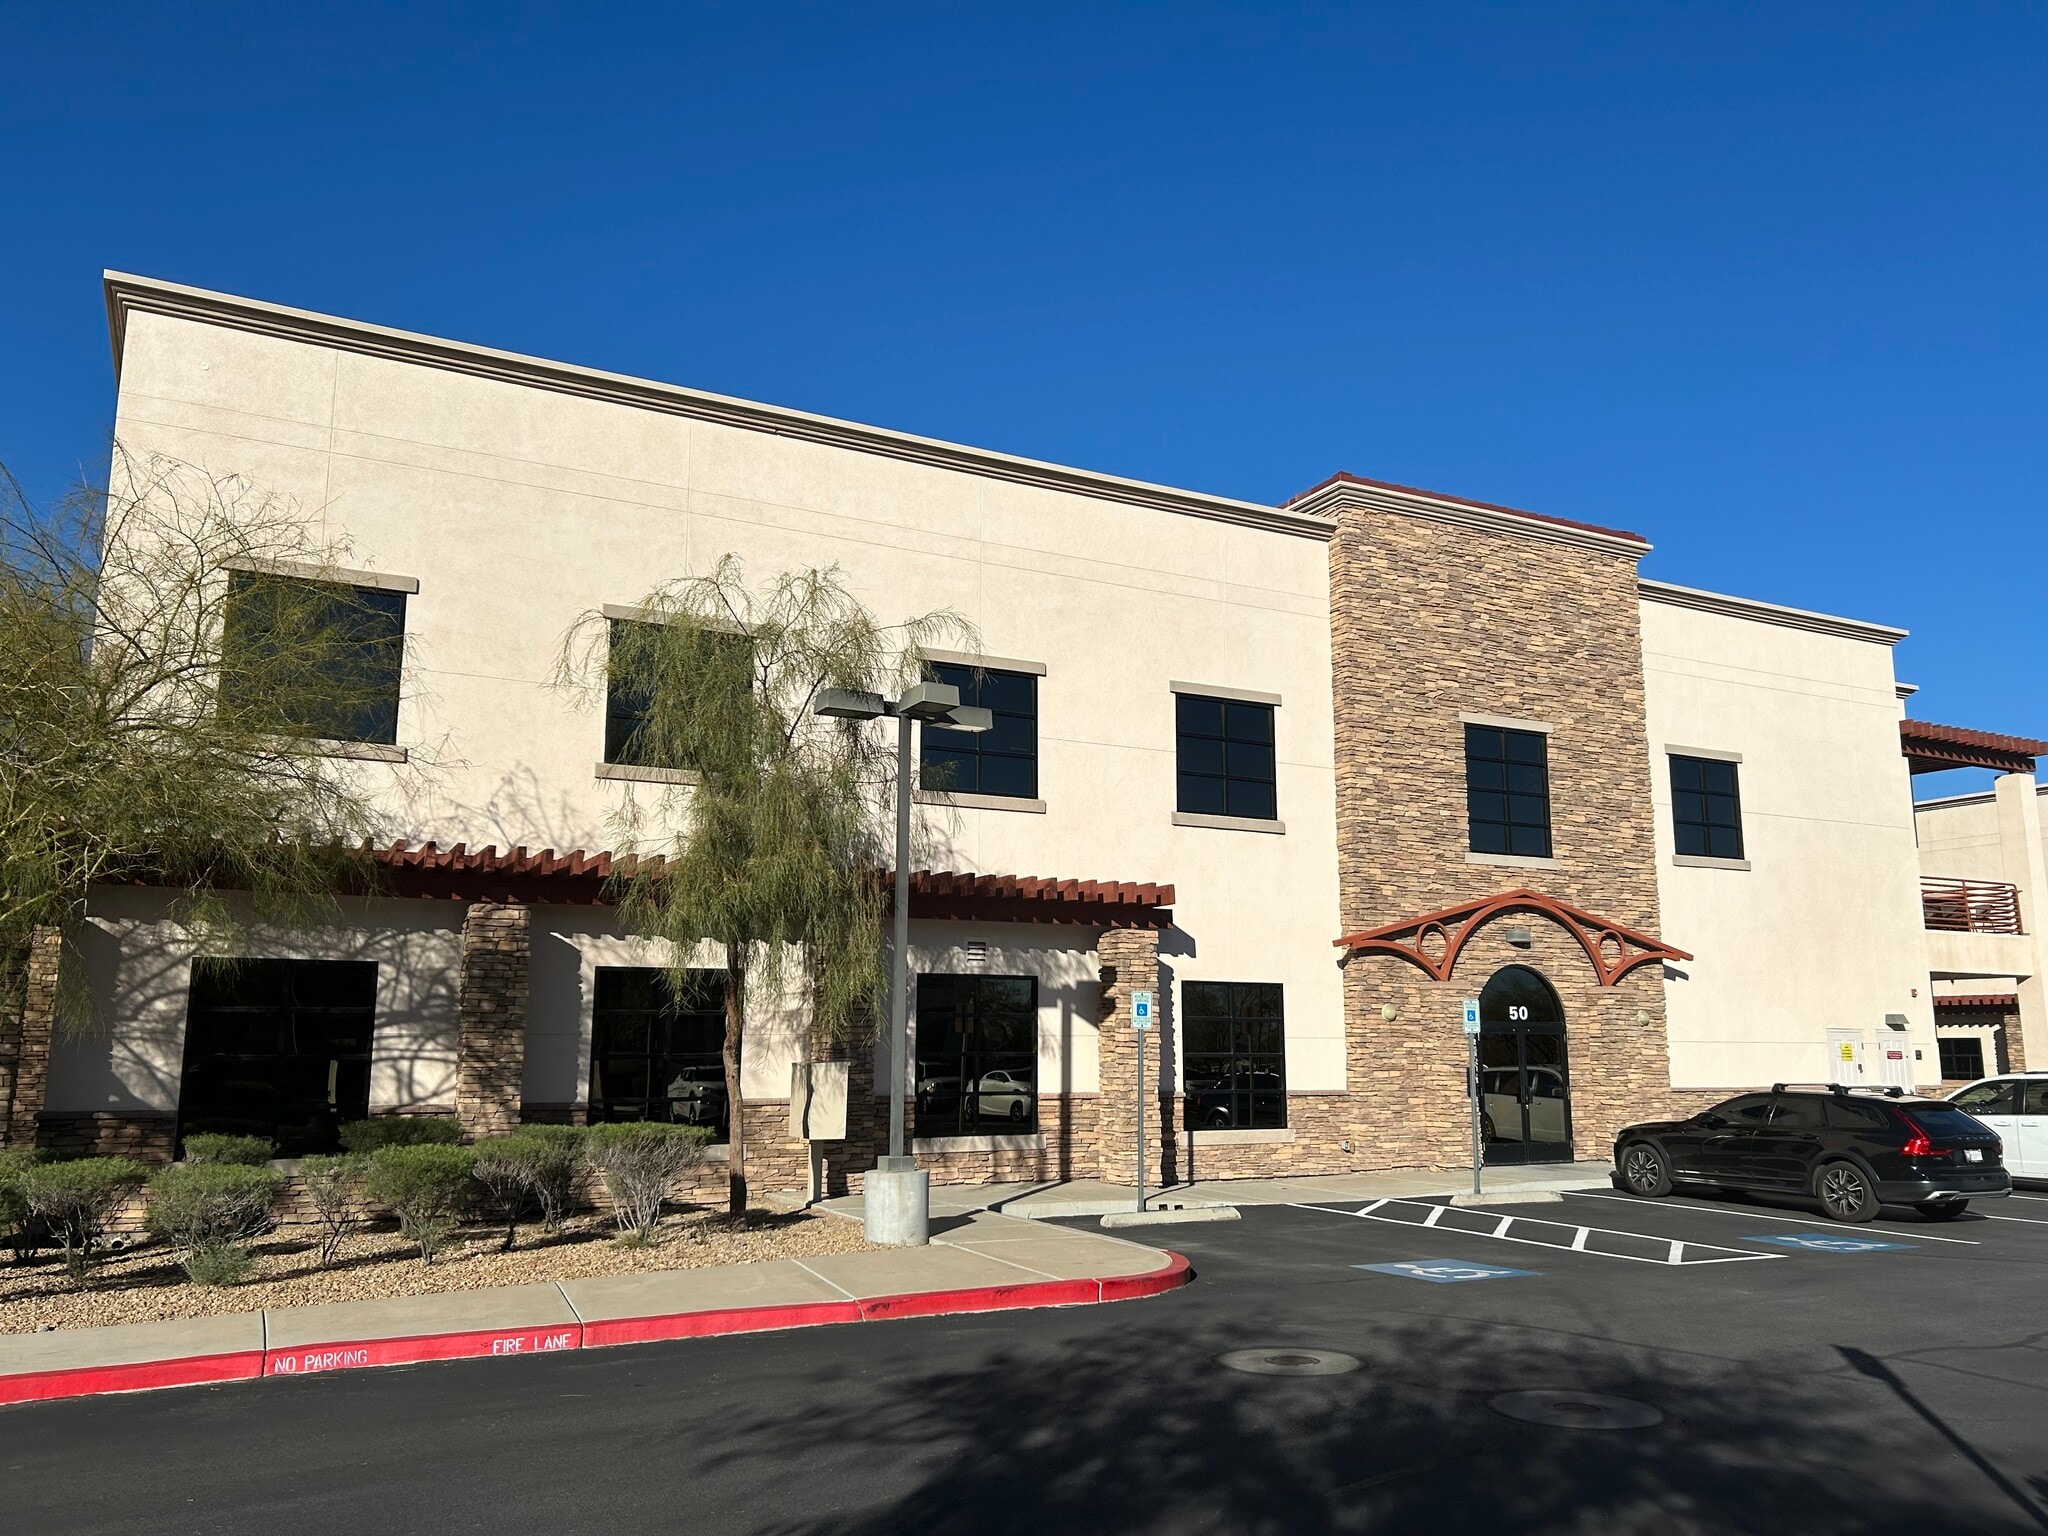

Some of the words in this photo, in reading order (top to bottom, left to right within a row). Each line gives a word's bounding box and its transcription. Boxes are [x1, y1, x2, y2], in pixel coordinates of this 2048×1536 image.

[1508, 1005, 1529, 1021] 50
[492, 1337, 526, 1355] FIRE
[534, 1333, 572, 1351] LANE
[274, 1356, 297, 1373] NO
[304, 1349, 368, 1371] PARKING
